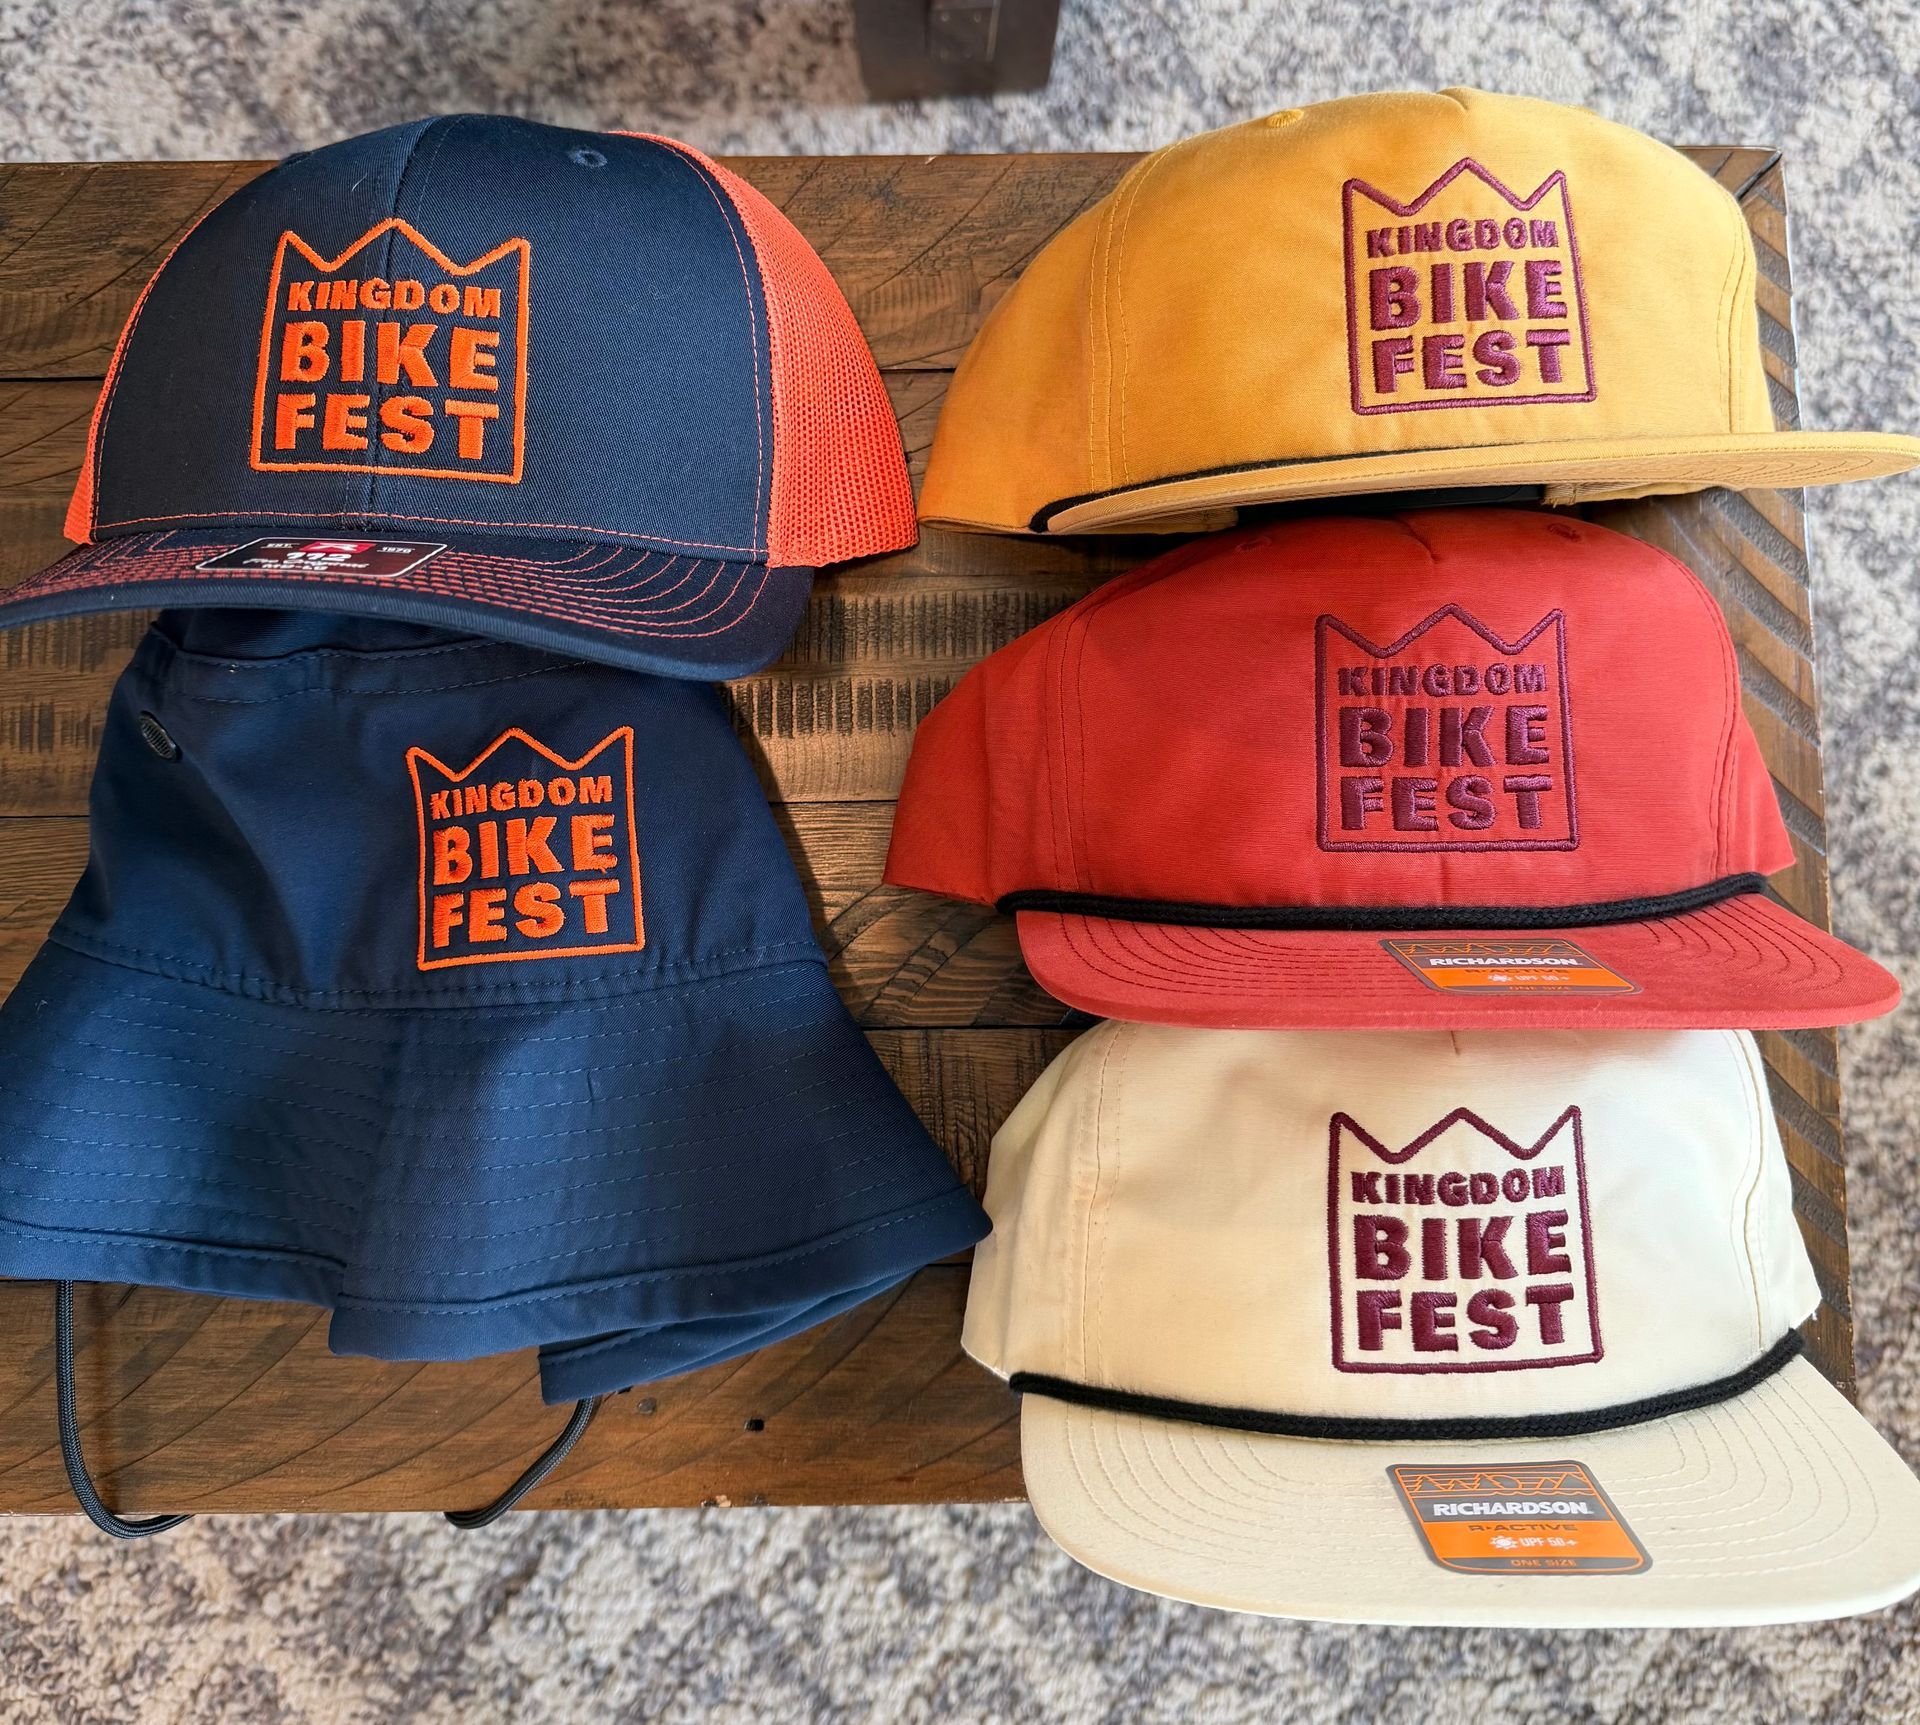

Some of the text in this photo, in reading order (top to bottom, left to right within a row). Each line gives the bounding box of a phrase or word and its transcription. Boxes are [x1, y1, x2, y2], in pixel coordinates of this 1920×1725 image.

[1365, 217, 1559, 258] KINGDOM
[287, 277, 501, 318] KINGDOM
[1369, 260, 1568, 331] BIKE
[280, 320, 500, 392] BIKE
[1371, 329, 1570, 394] FEST
[275, 393, 499, 460] FEST
[286, 551, 352, 562] 112
[1338, 663, 1547, 697] KINGDOM
[1339, 704, 1549, 768] BIKE
[430, 775, 613, 820] KINGDOM
[1340, 774, 1552, 832] FEST
[433, 814, 618, 886] BIKE
[433, 878, 620, 948] FEST
[1429, 957, 1579, 967] RICHARDSON
[1350, 1165, 1566, 1206] KINGDOM
[1353, 1208, 1572, 1281] BIKE
[1356, 1282, 1574, 1352] FEST
[1433, 1501, 1588, 1516] RICHARDSON
[1510, 1559, 1577, 1567] ONE SIZE
[1519, 1537, 1545, 1547] UPF
